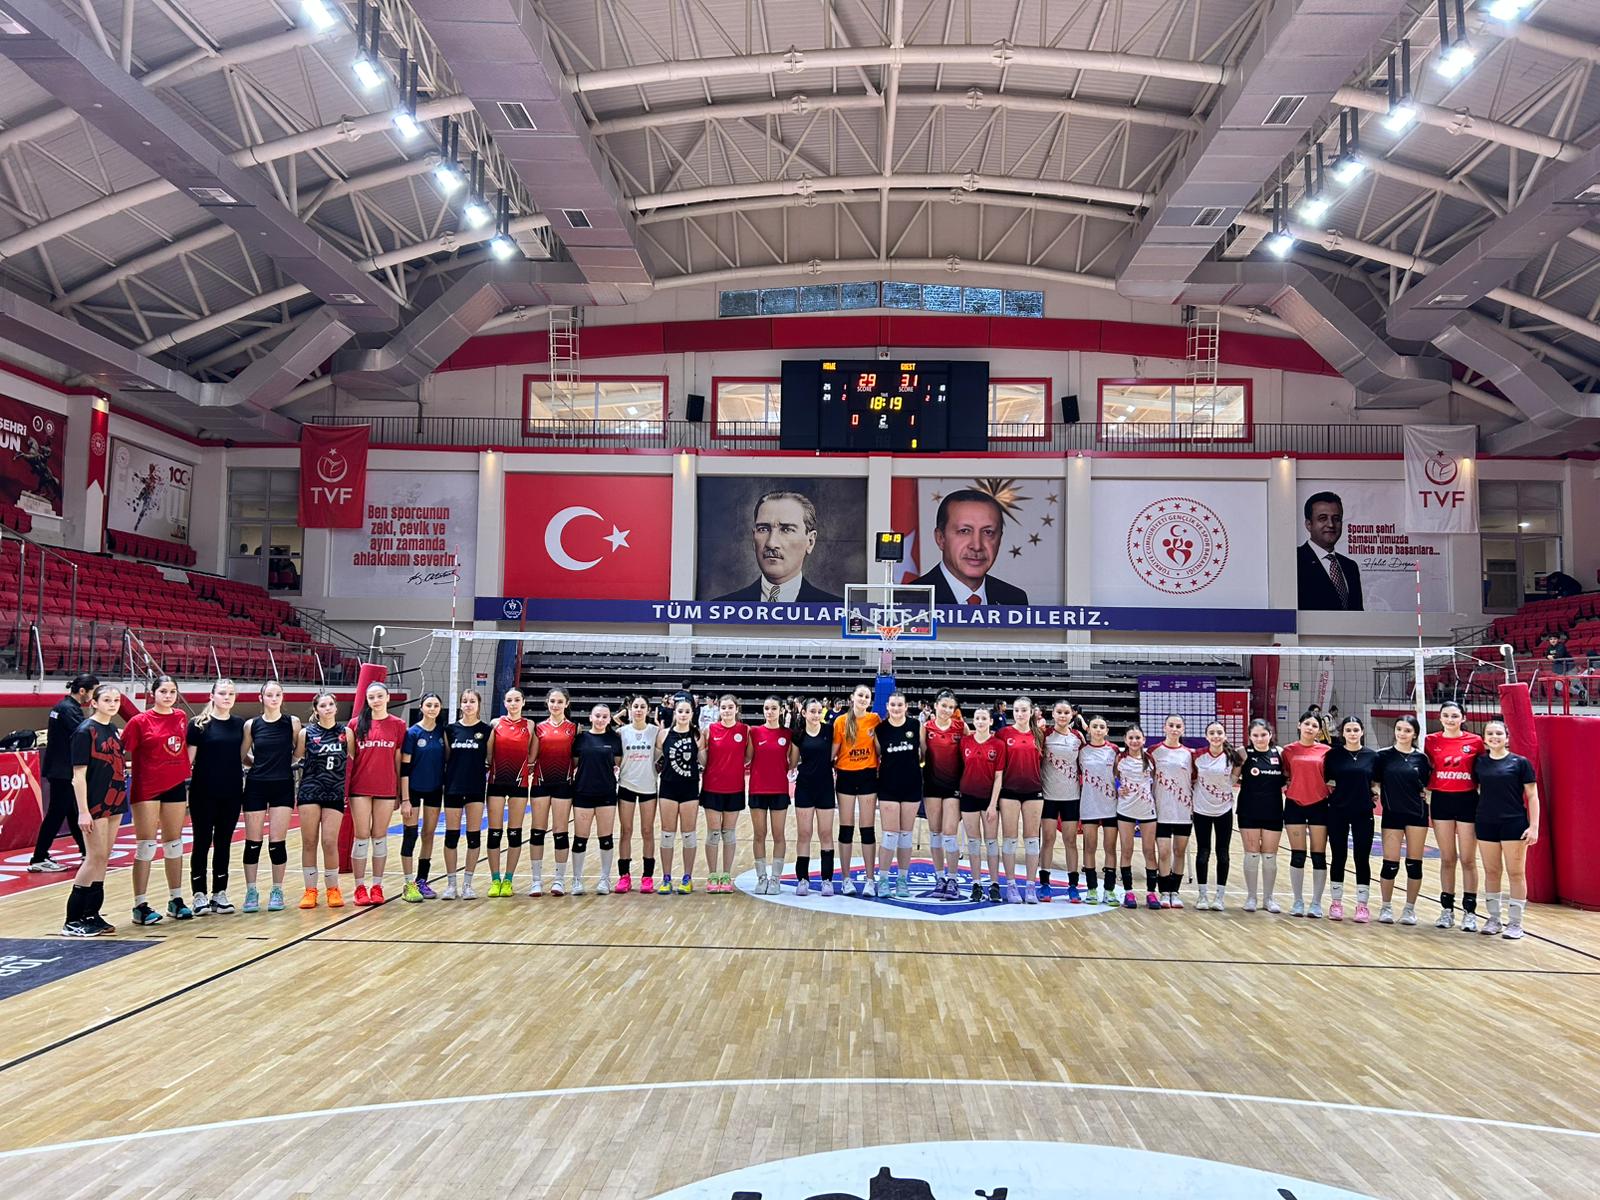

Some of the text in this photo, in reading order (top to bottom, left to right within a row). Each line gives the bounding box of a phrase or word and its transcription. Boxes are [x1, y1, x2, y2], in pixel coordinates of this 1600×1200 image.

[859, 373, 918, 387] 29 31
[870, 396, 903, 410] 18:19
[852, 414, 859, 425] 0
[880, 414, 887, 425] 2
[310, 487, 353, 504] TVF
[1418, 491, 1465, 508] TVF
[368, 505, 450, 521] Ben sporcunun
[371, 521, 446, 536] zeki, çevik ve
[1347, 523, 1374, 535] Sporun
[370, 537, 446, 552] aynı zamanda
[1347, 534, 1409, 545] Samsun'umuzda
[1348, 545, 1375, 555] birlikte
[1377, 545, 1393, 555] nice
[652, 601, 702, 619] TÜM
[1008, 607, 1110, 626] DİLERİZ.
[325, 756, 335, 770] 6
